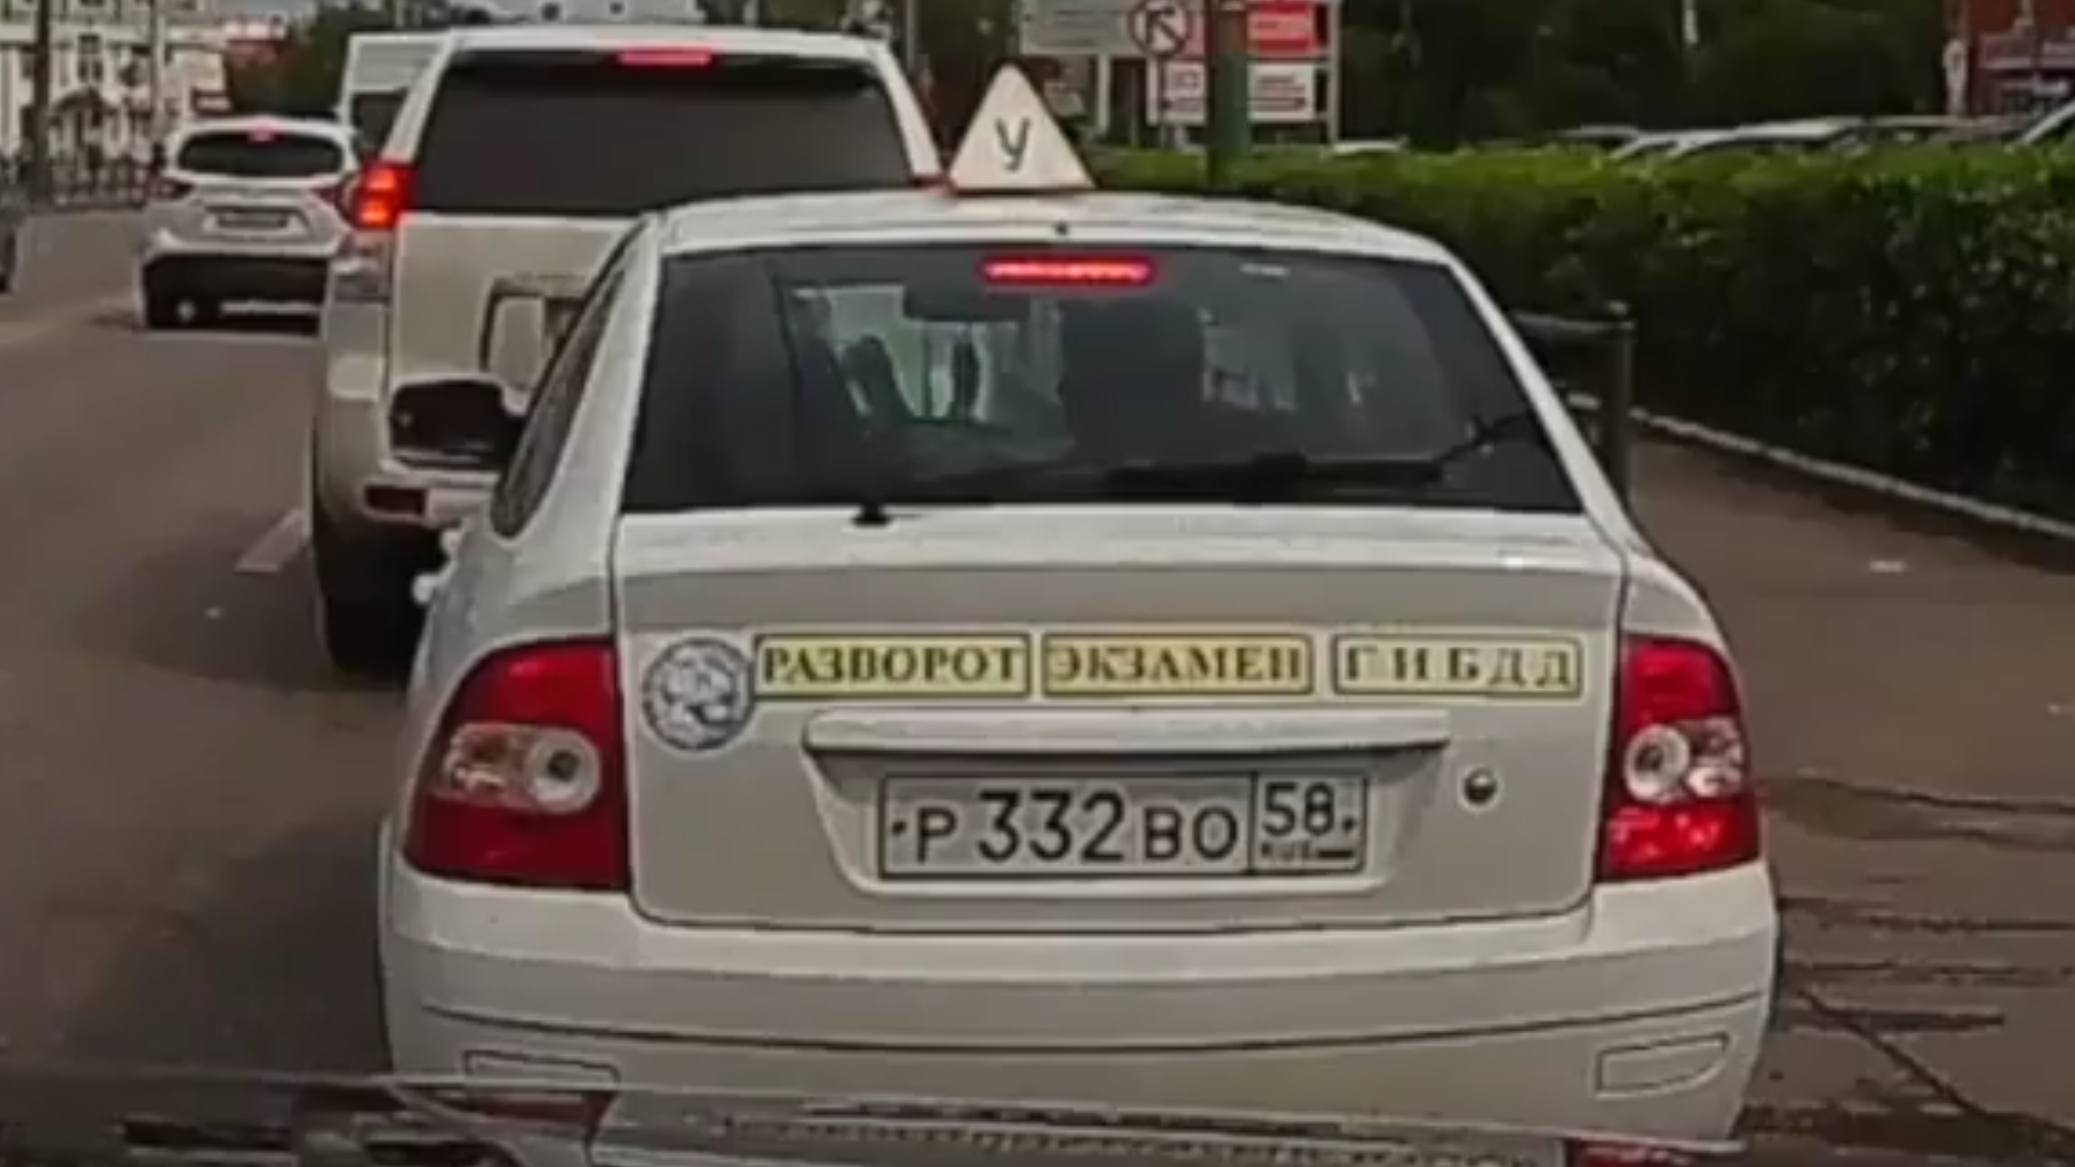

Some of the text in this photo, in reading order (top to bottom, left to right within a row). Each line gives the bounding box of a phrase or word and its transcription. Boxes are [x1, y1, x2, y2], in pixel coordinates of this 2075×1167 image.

[763, 646, 1019, 683] РАЗВОРОТ
[1050, 646, 1300, 682] ЭКЗАМЕН
[1262, 780, 1336, 836] 58
